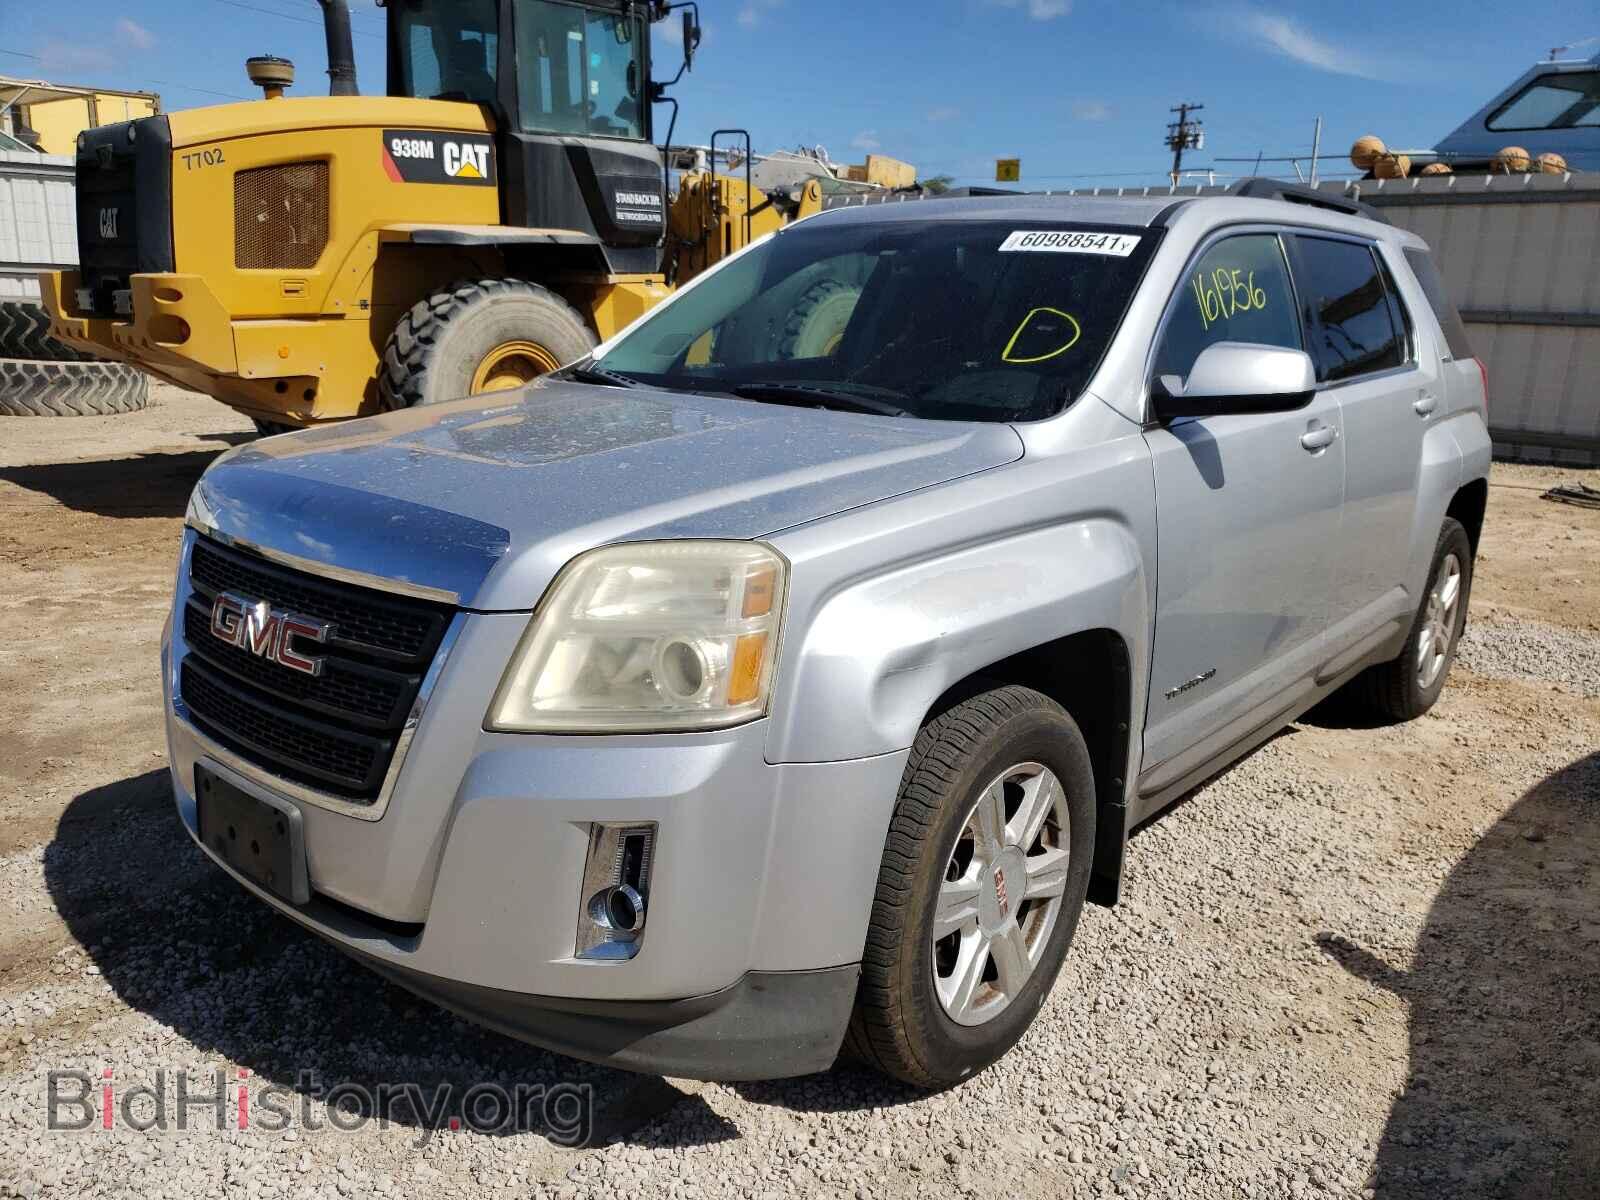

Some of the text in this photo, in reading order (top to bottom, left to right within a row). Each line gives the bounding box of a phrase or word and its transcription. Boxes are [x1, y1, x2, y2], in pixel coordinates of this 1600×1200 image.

[182, 148, 226, 170] 7702
[391, 138, 435, 159] 938M
[443, 141, 489, 178] CAT
[100, 207, 119, 238] CAT
[1020, 232, 1122, 250] 60988541
[1192, 268, 1266, 331] 161956
[210, 591, 330, 677] GMC
